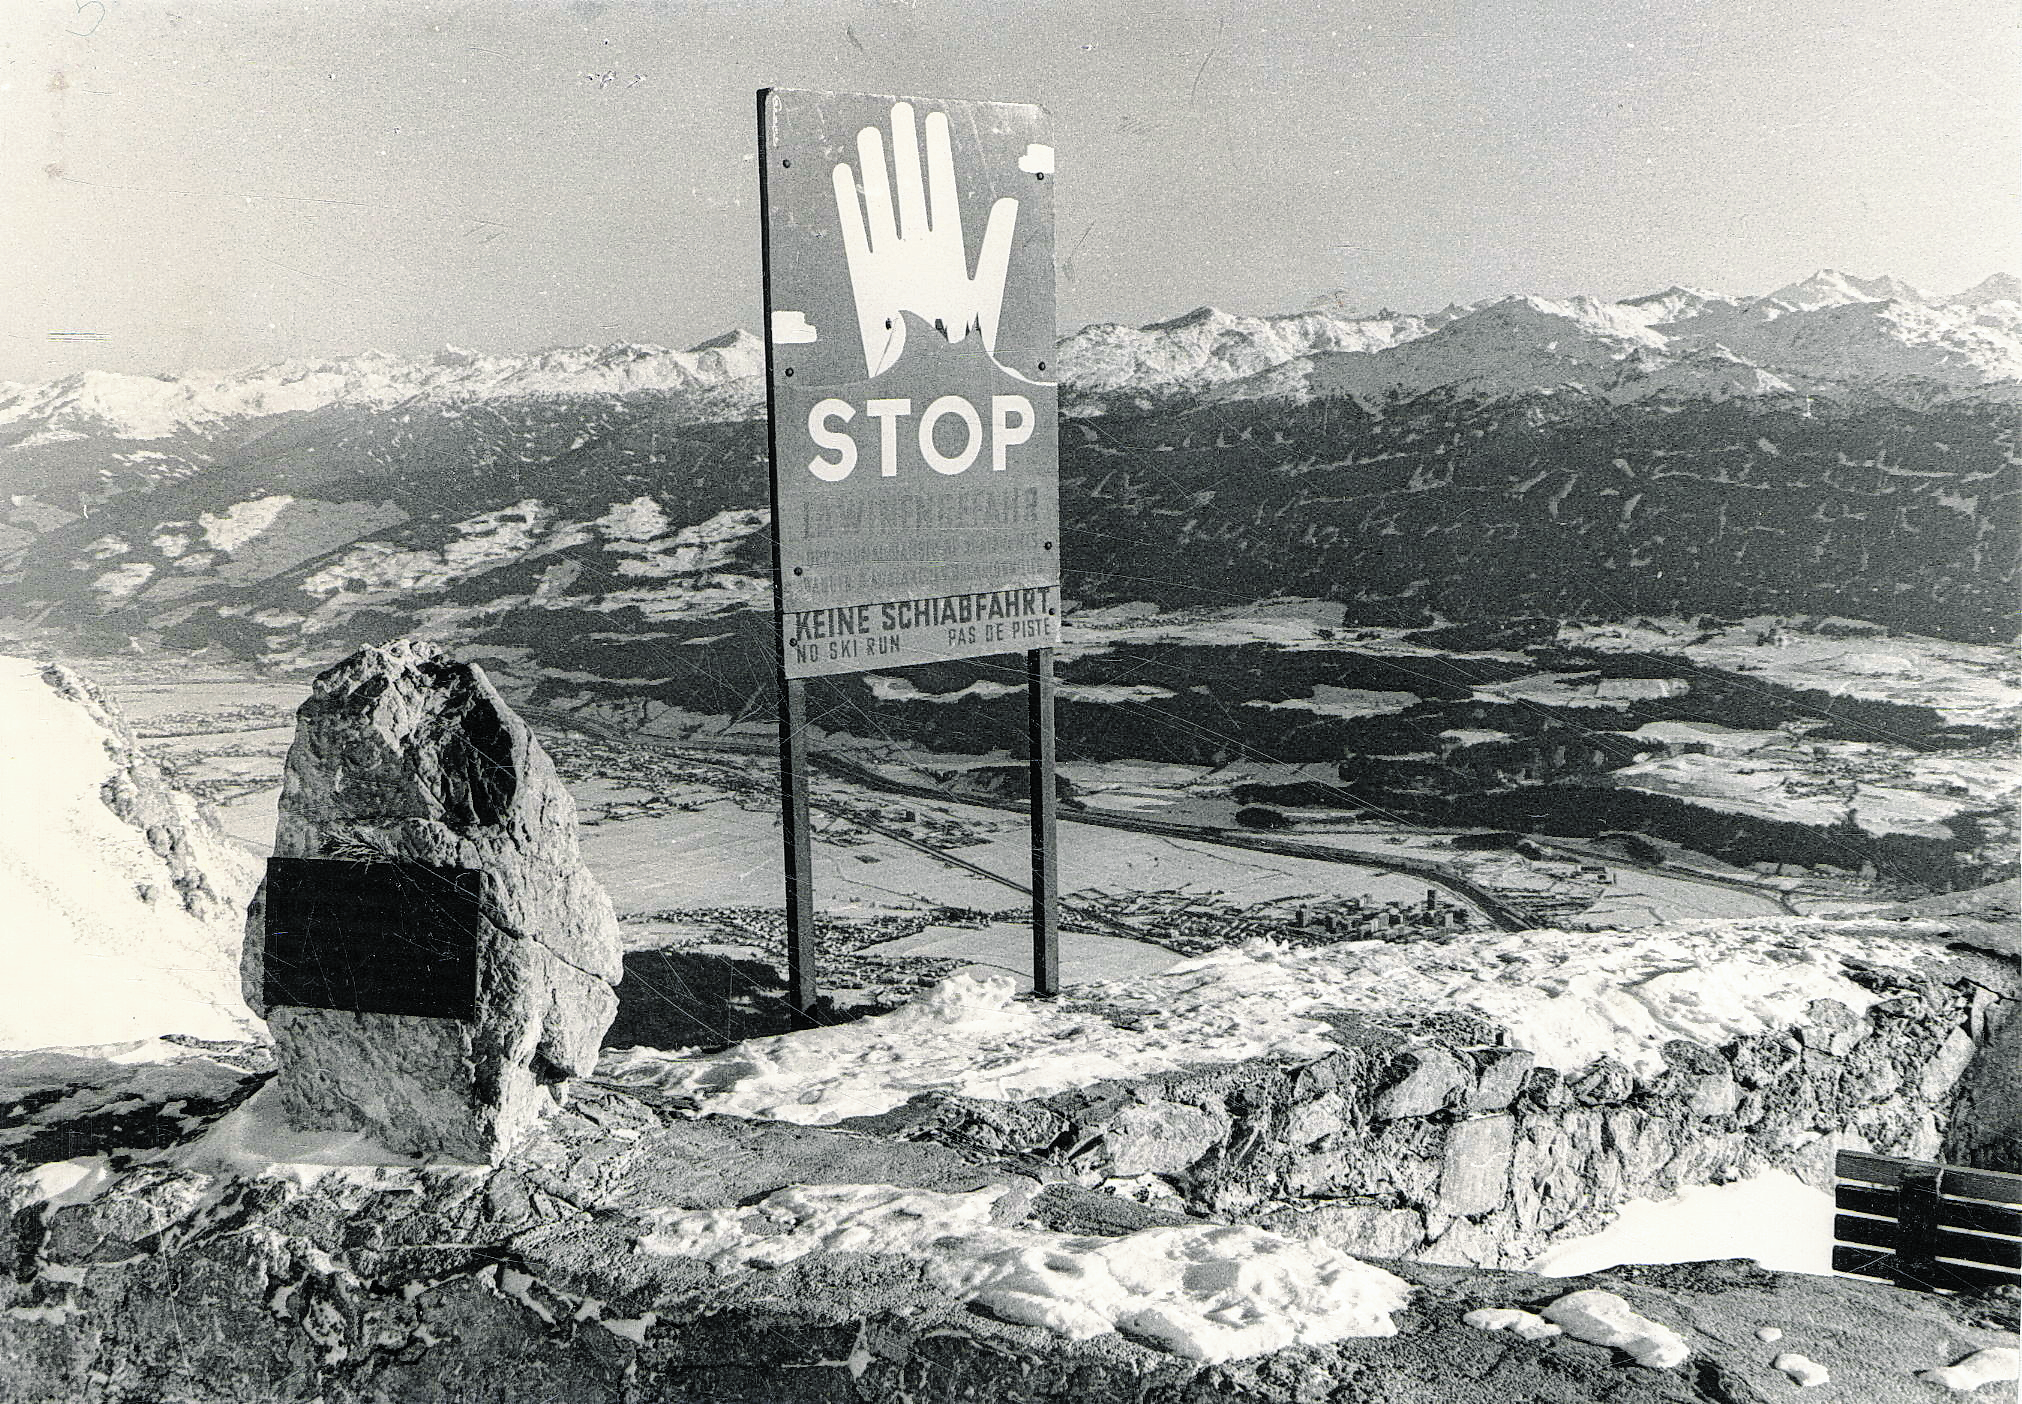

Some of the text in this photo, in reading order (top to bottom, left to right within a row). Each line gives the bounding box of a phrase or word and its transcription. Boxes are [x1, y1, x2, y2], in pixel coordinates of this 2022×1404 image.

[808, 395, 1036, 482] STOP
[796, 586, 1050, 641] KEINE SCHIABFAHRT
[948, 617, 1051, 646] PAS DE PISTE
[797, 634, 900, 664] NO SKI RUN
